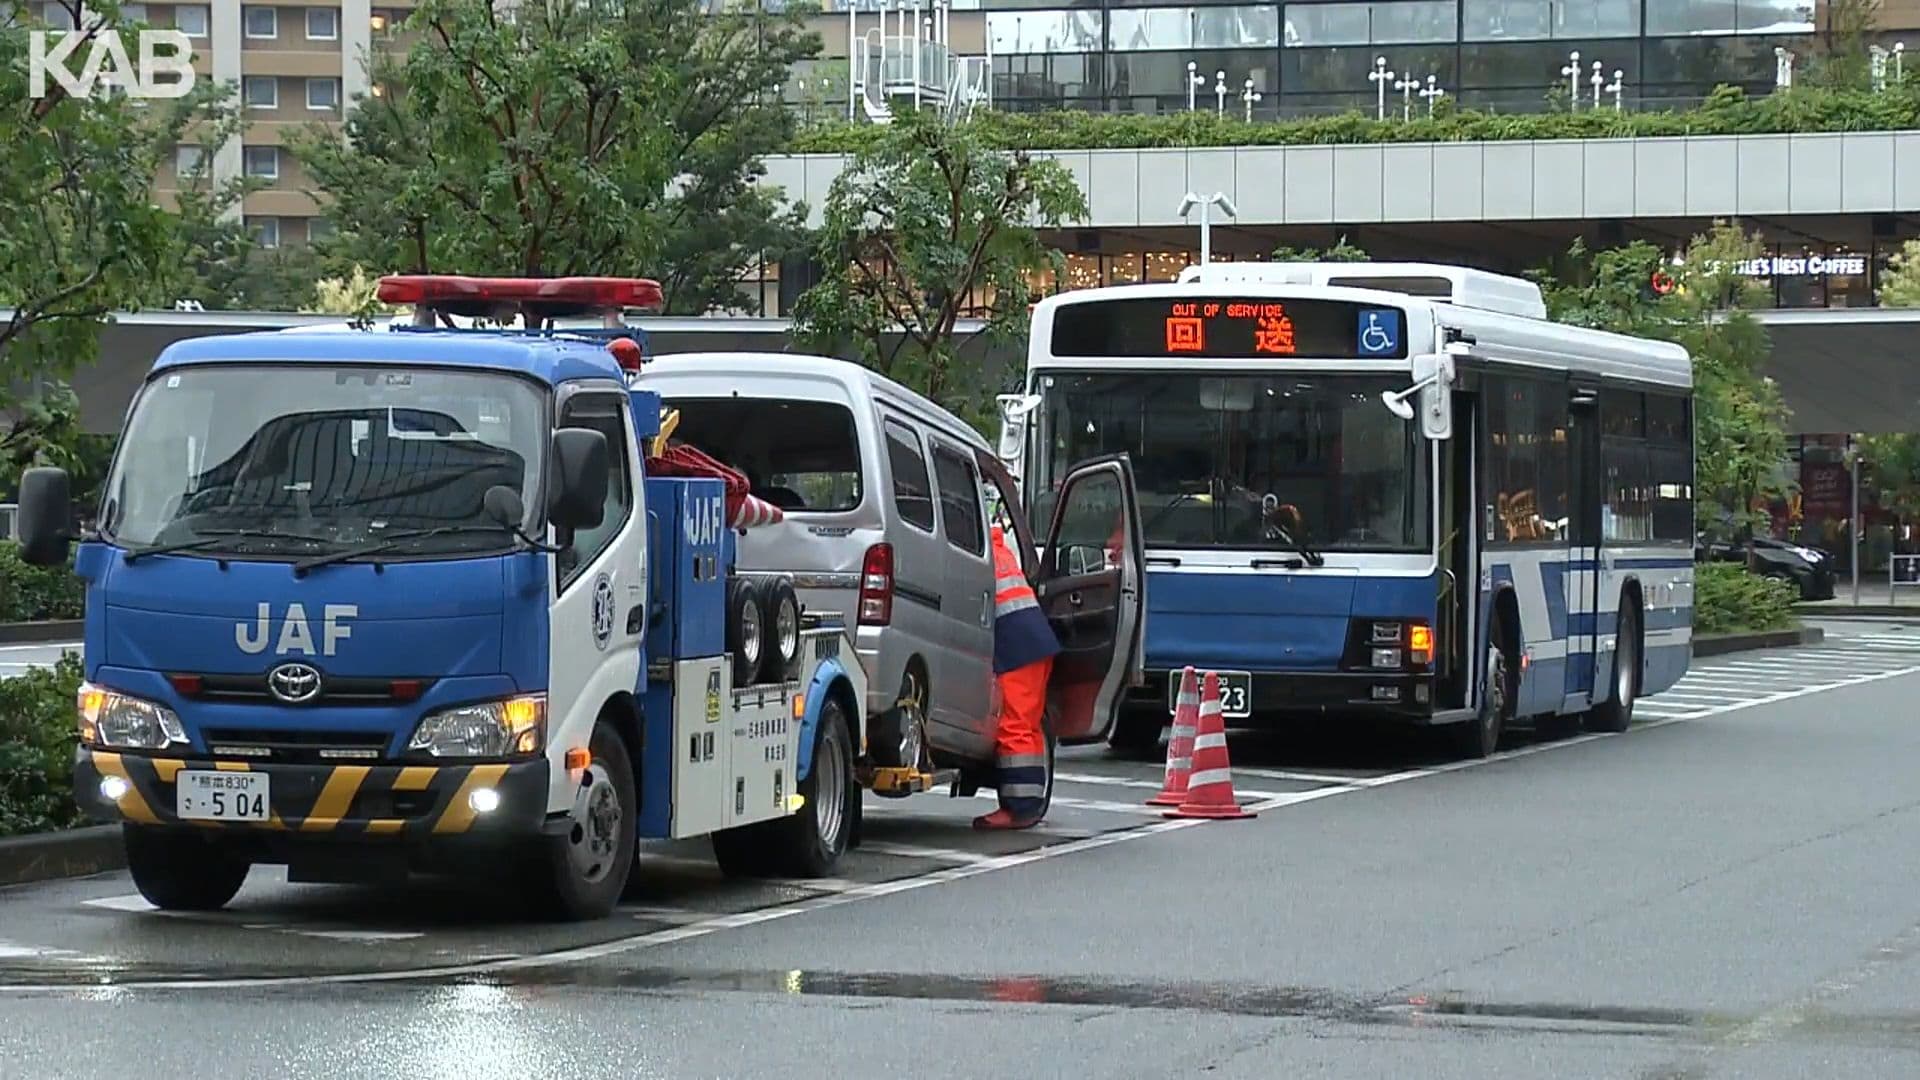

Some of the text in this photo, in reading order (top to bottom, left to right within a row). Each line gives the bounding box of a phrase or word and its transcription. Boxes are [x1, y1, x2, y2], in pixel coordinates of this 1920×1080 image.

[1808, 256, 1865, 275] COFFEE
[1172, 304, 1283, 317] OUT OF SERVICE
[690, 497, 721, 546] JAF
[235, 602, 358, 656] JAF
